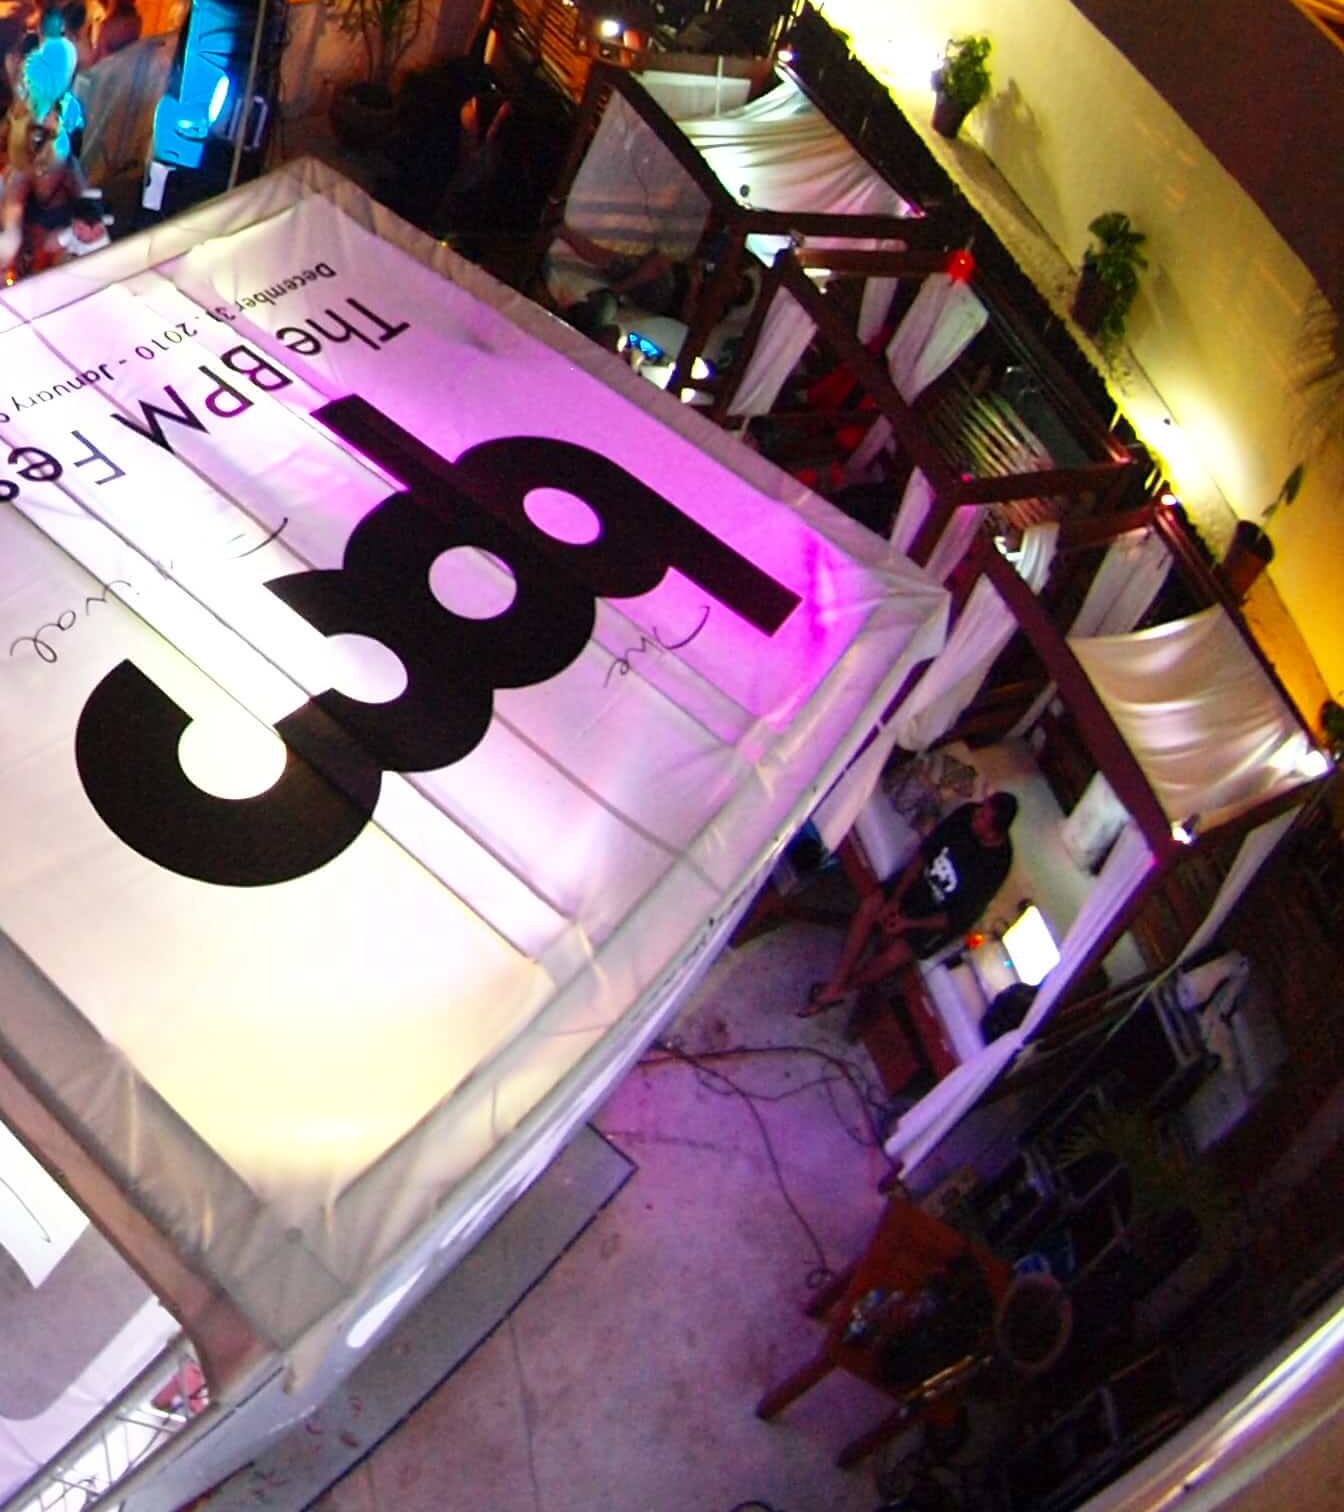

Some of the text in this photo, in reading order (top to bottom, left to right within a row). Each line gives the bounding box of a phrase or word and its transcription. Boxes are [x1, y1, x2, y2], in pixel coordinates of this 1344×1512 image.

[235, 262, 337, 312] December
[135, 322, 198, 360] 2010
[277, 296, 411, 357] The
[11, 363, 115, 412] January
[111, 344, 294, 454] BPM
[76, 393, 802, 888] bpm
